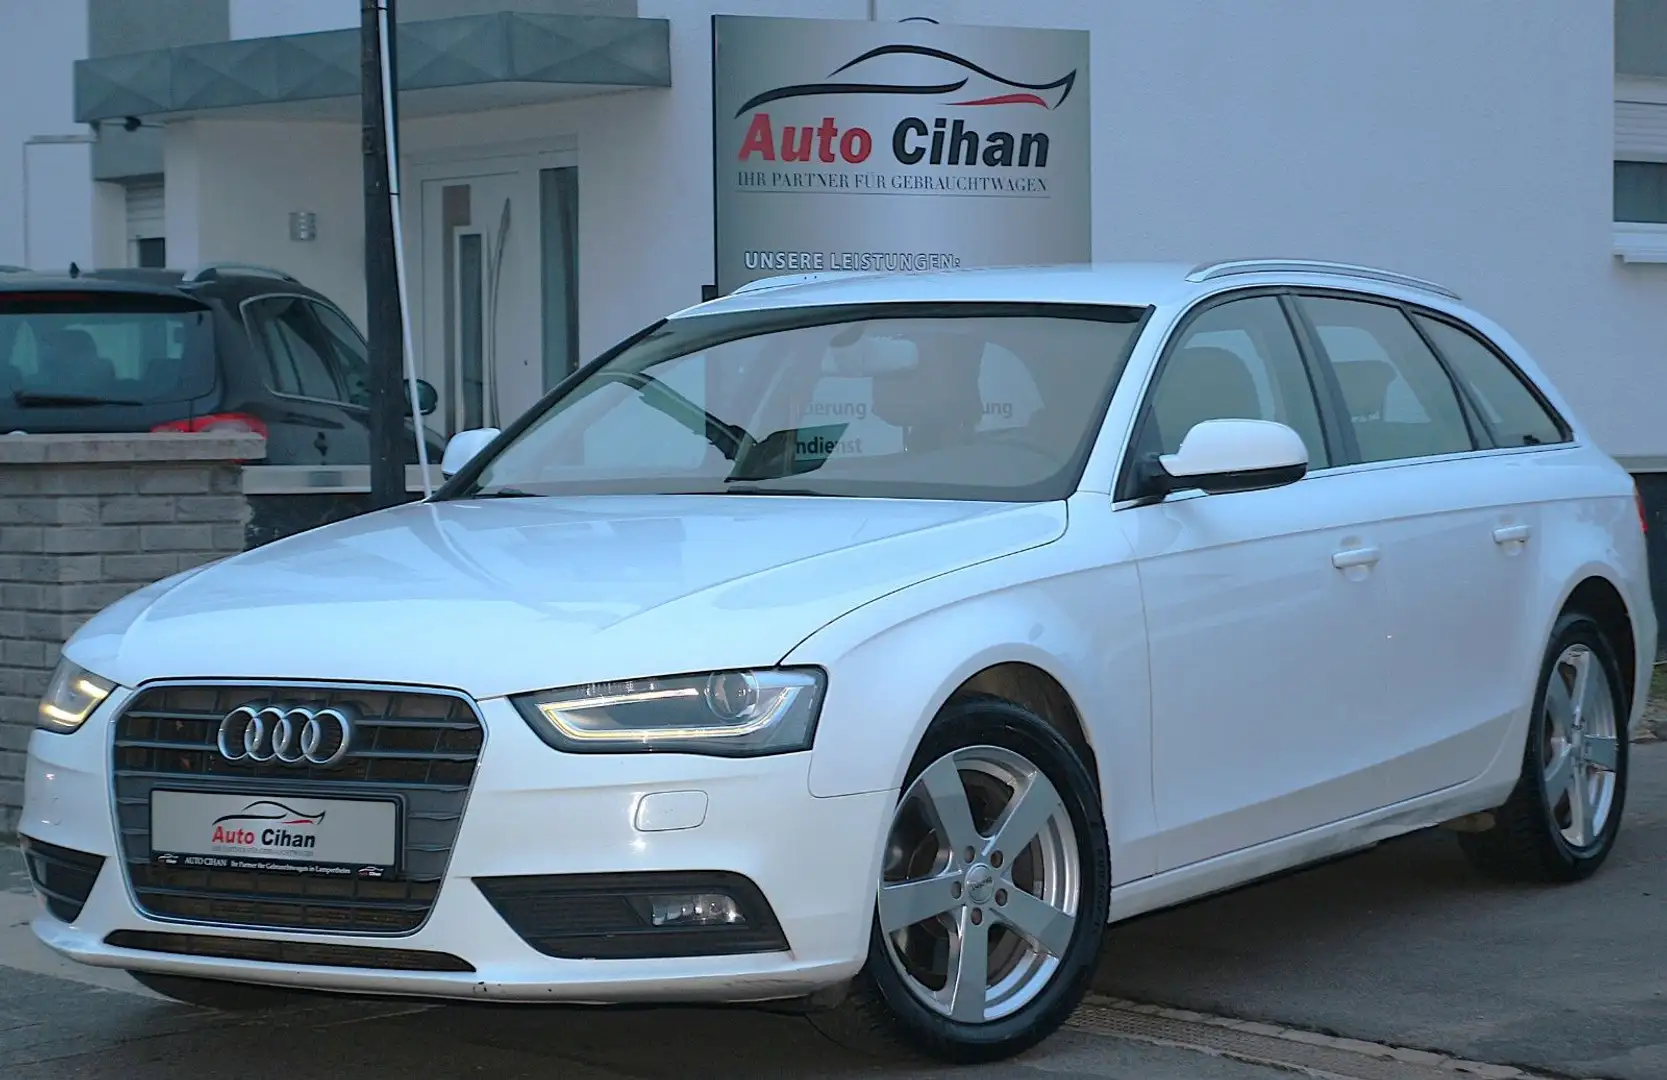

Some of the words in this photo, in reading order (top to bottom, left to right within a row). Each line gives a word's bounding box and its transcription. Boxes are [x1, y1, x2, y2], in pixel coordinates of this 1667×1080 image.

[738, 113, 872, 164] Auto
[892, 117, 1050, 167] Cihan
[738, 171, 767, 187] IHR
[772, 172, 850, 189] PARTNER
[855, 172, 888, 189] FÜR
[891, 175, 1048, 192] GEBRAUCHTWAGEN
[745, 252, 824, 270] UNSERE
[830, 252, 961, 271] LEISTUNGEN:
[212, 826, 255, 845] Auto
[261, 828, 316, 848] Cihan
[184, 857, 204, 865] AUTO
[204, 858, 228, 867] CIHAN
